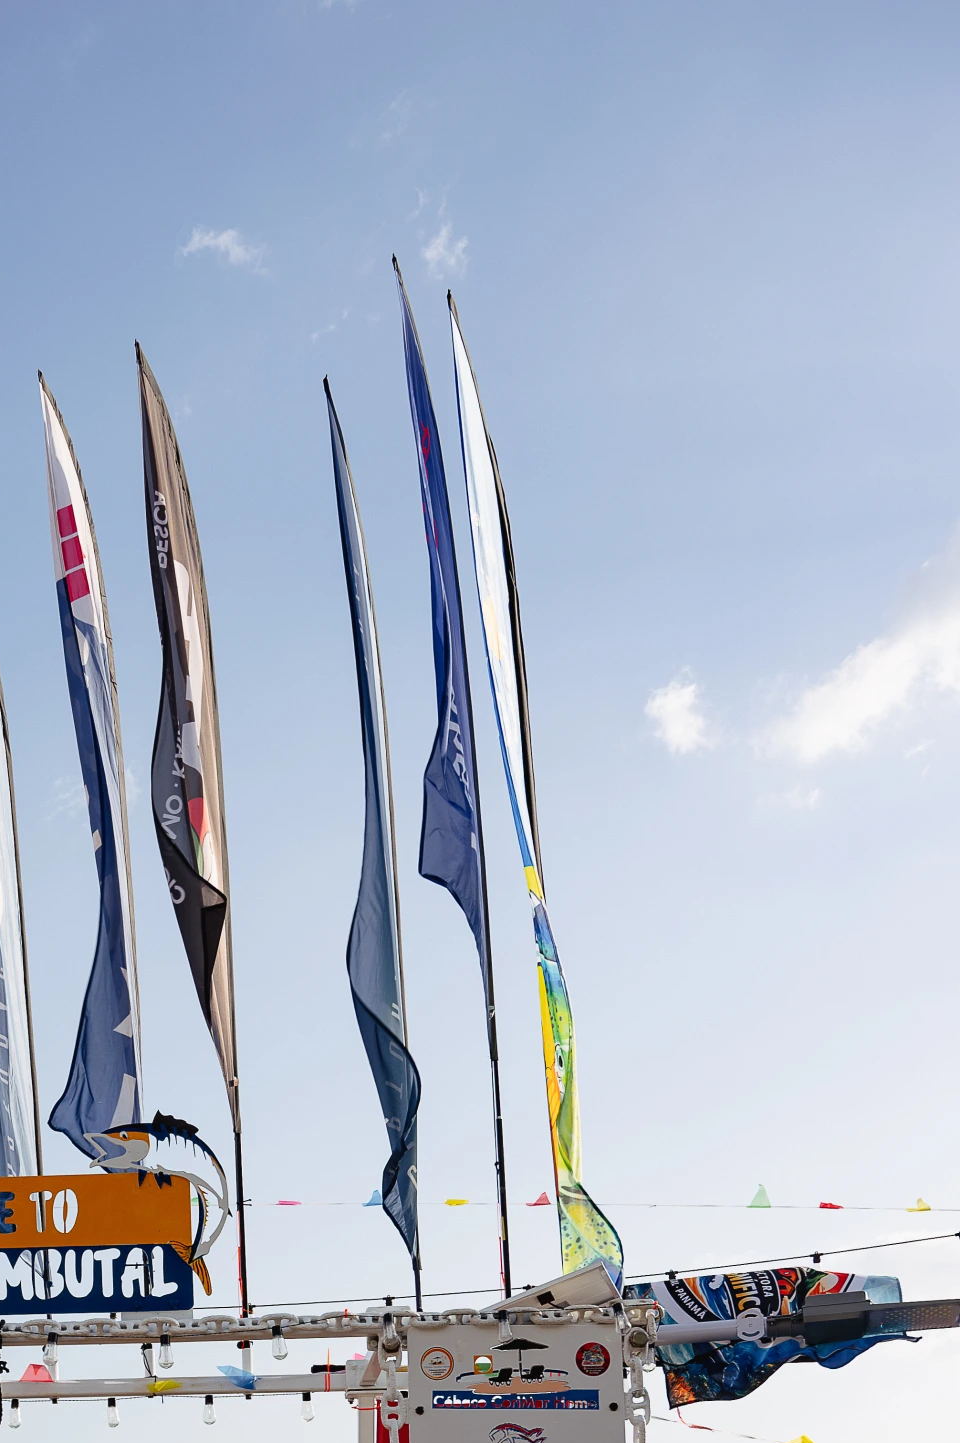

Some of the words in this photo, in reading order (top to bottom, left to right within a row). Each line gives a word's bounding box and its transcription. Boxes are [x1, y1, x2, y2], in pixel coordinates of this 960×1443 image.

[29, 1188, 79, 1234] TO
[433, 1394, 487, 1408] Cébaco
[491, 1395, 549, 1408] CoriMar
[553, 1396, 598, 1408] Home
